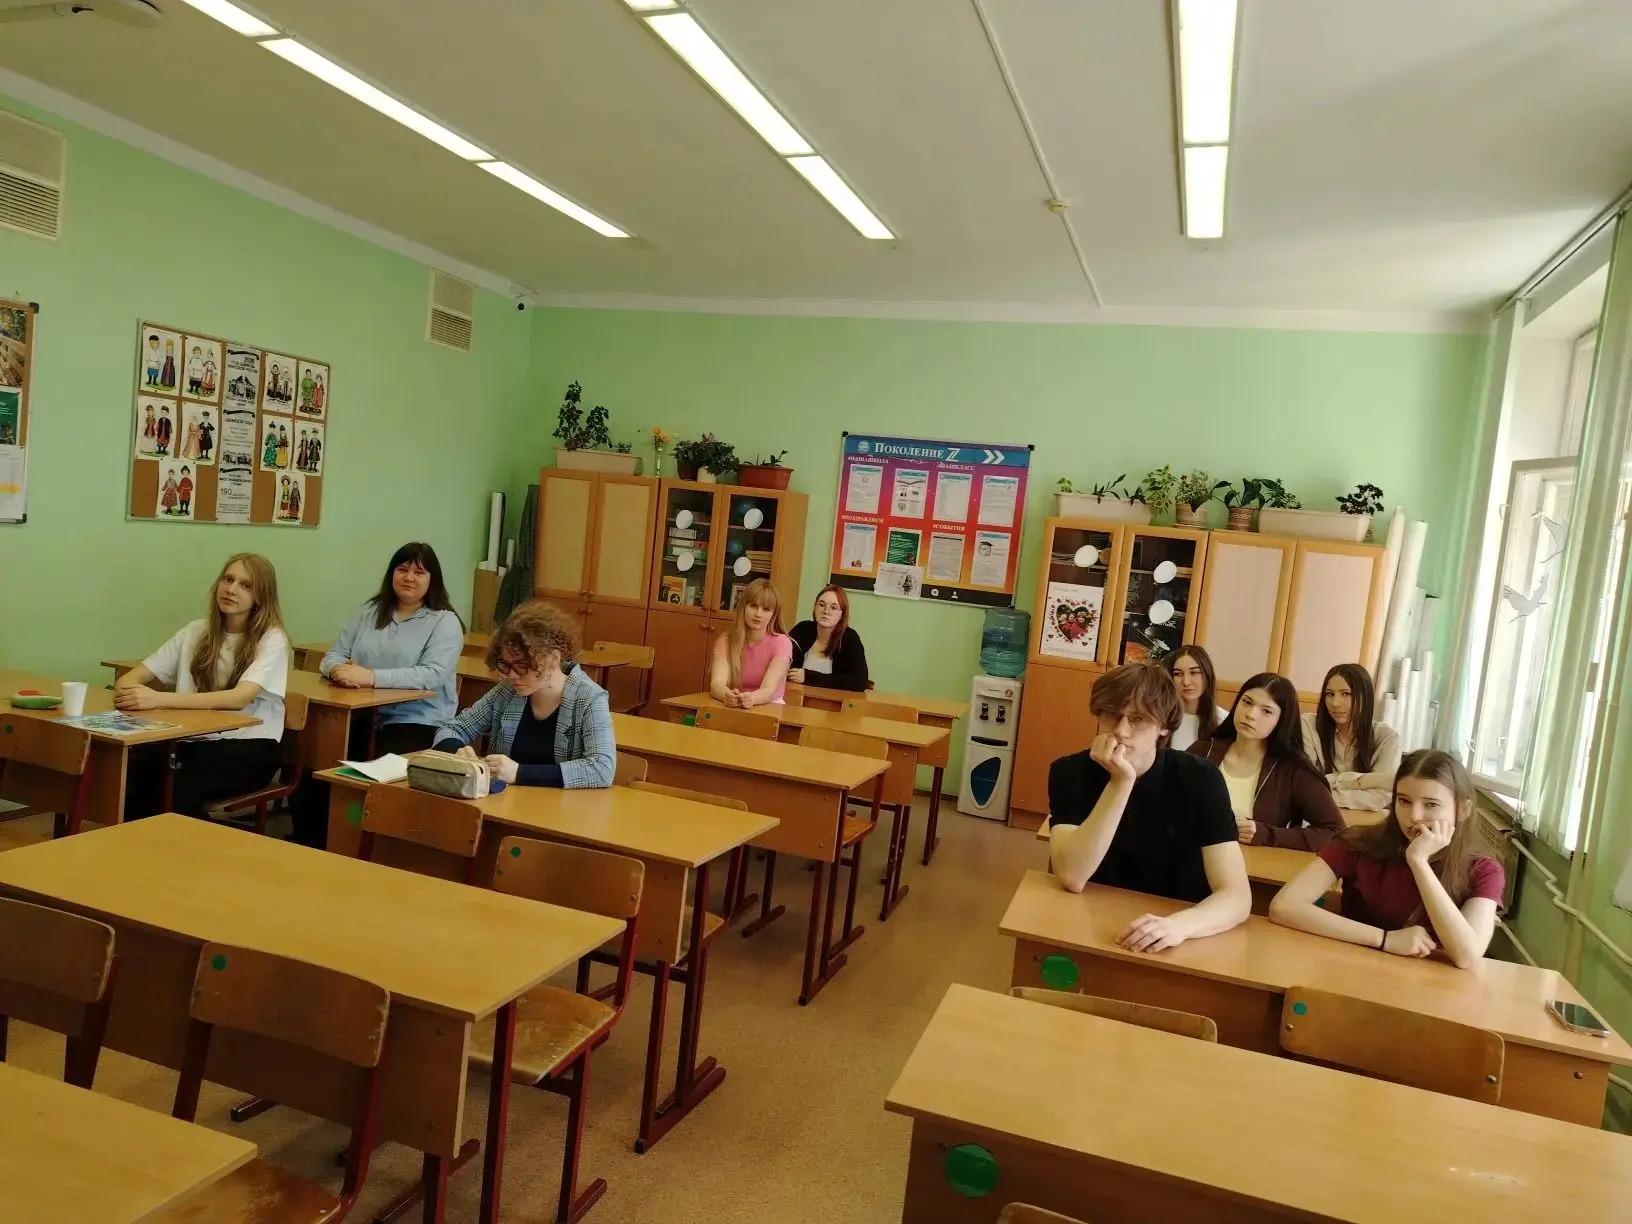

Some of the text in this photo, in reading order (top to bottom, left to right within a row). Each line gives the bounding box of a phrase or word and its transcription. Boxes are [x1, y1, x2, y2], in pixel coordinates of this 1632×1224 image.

[875, 442, 961, 462] ПОКОЛЕНИЕ Z
[219, 488, 232, 496] 190
